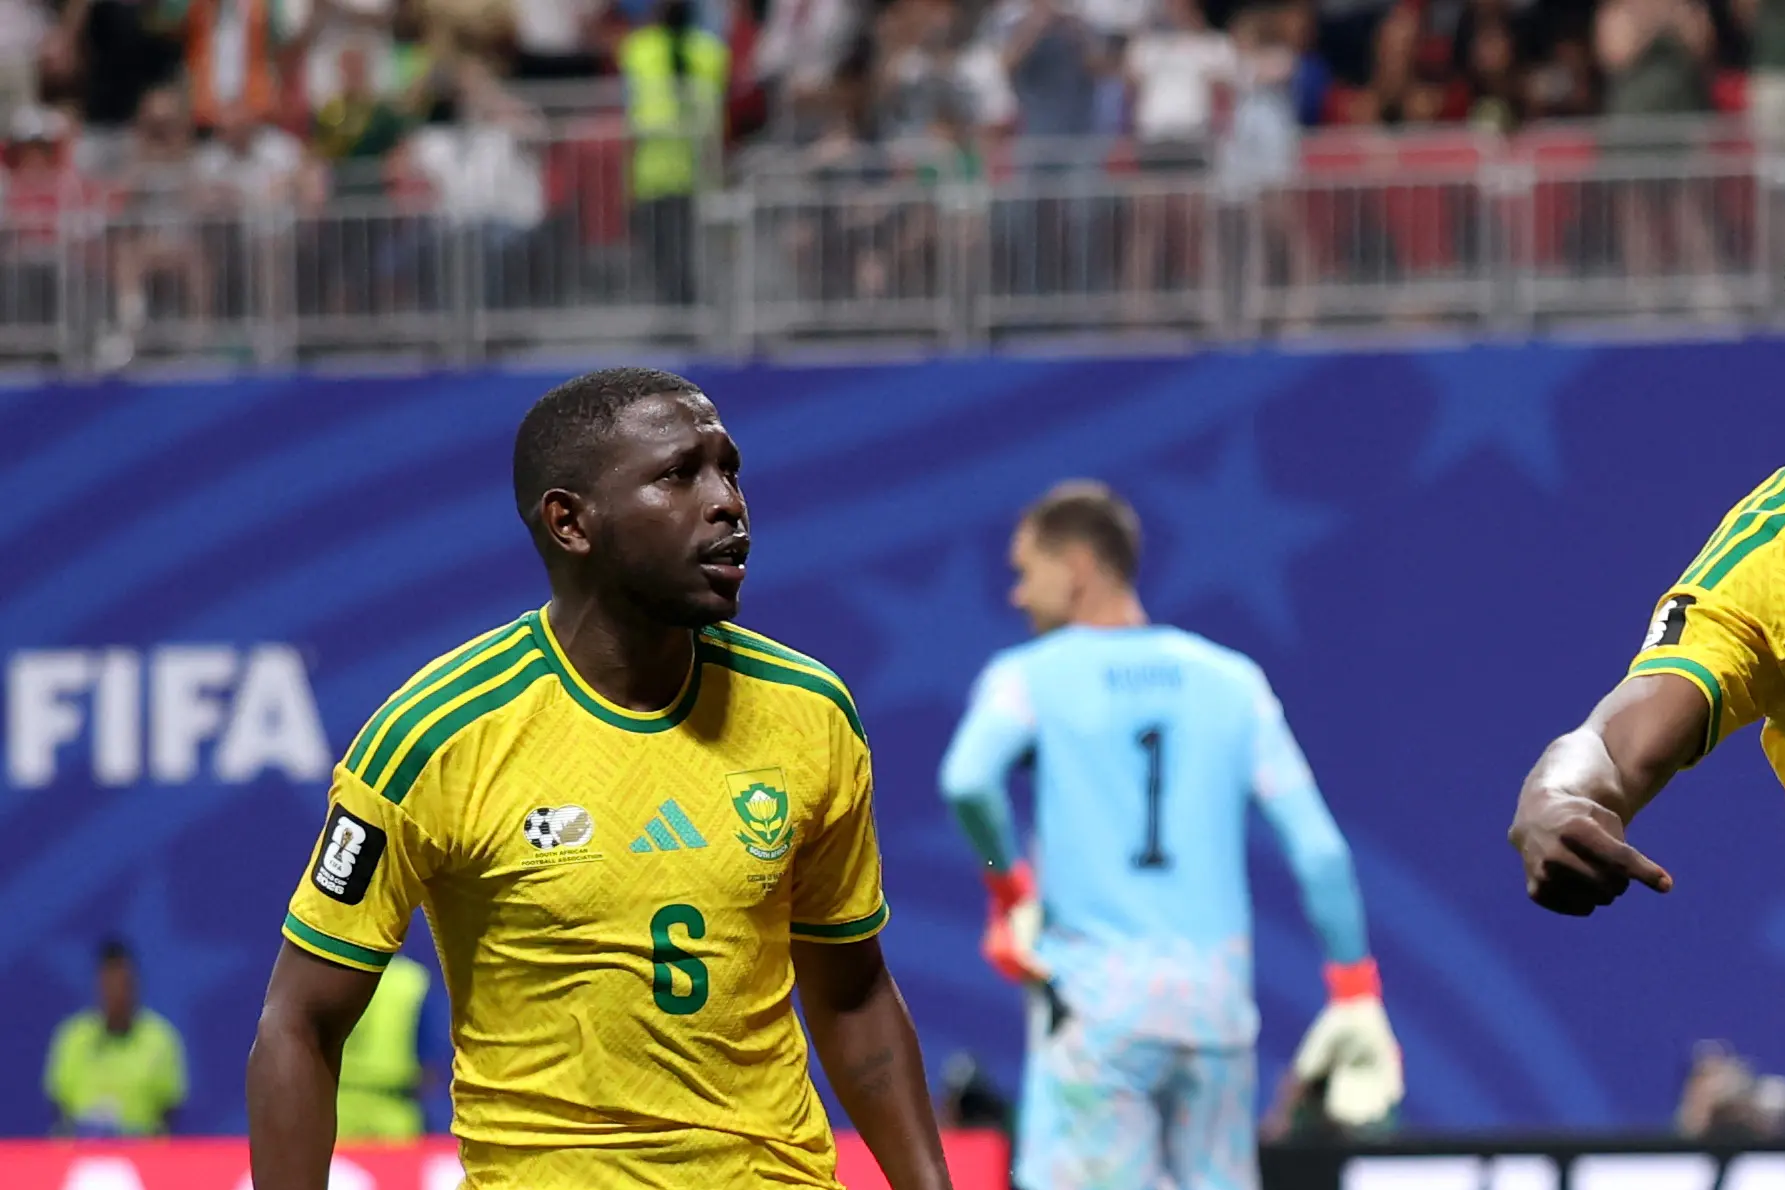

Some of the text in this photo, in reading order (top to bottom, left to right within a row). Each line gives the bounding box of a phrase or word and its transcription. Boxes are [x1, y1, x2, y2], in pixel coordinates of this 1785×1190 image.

[5, 645, 334, 788] FIFA
[1128, 724, 1175, 870] 1
[316, 872, 345, 895] 2026
[521, 853, 603, 866] FOOTBALL ASSOCIATION
[749, 845, 770, 859] SOUTH
[650, 904, 709, 1015] 6
